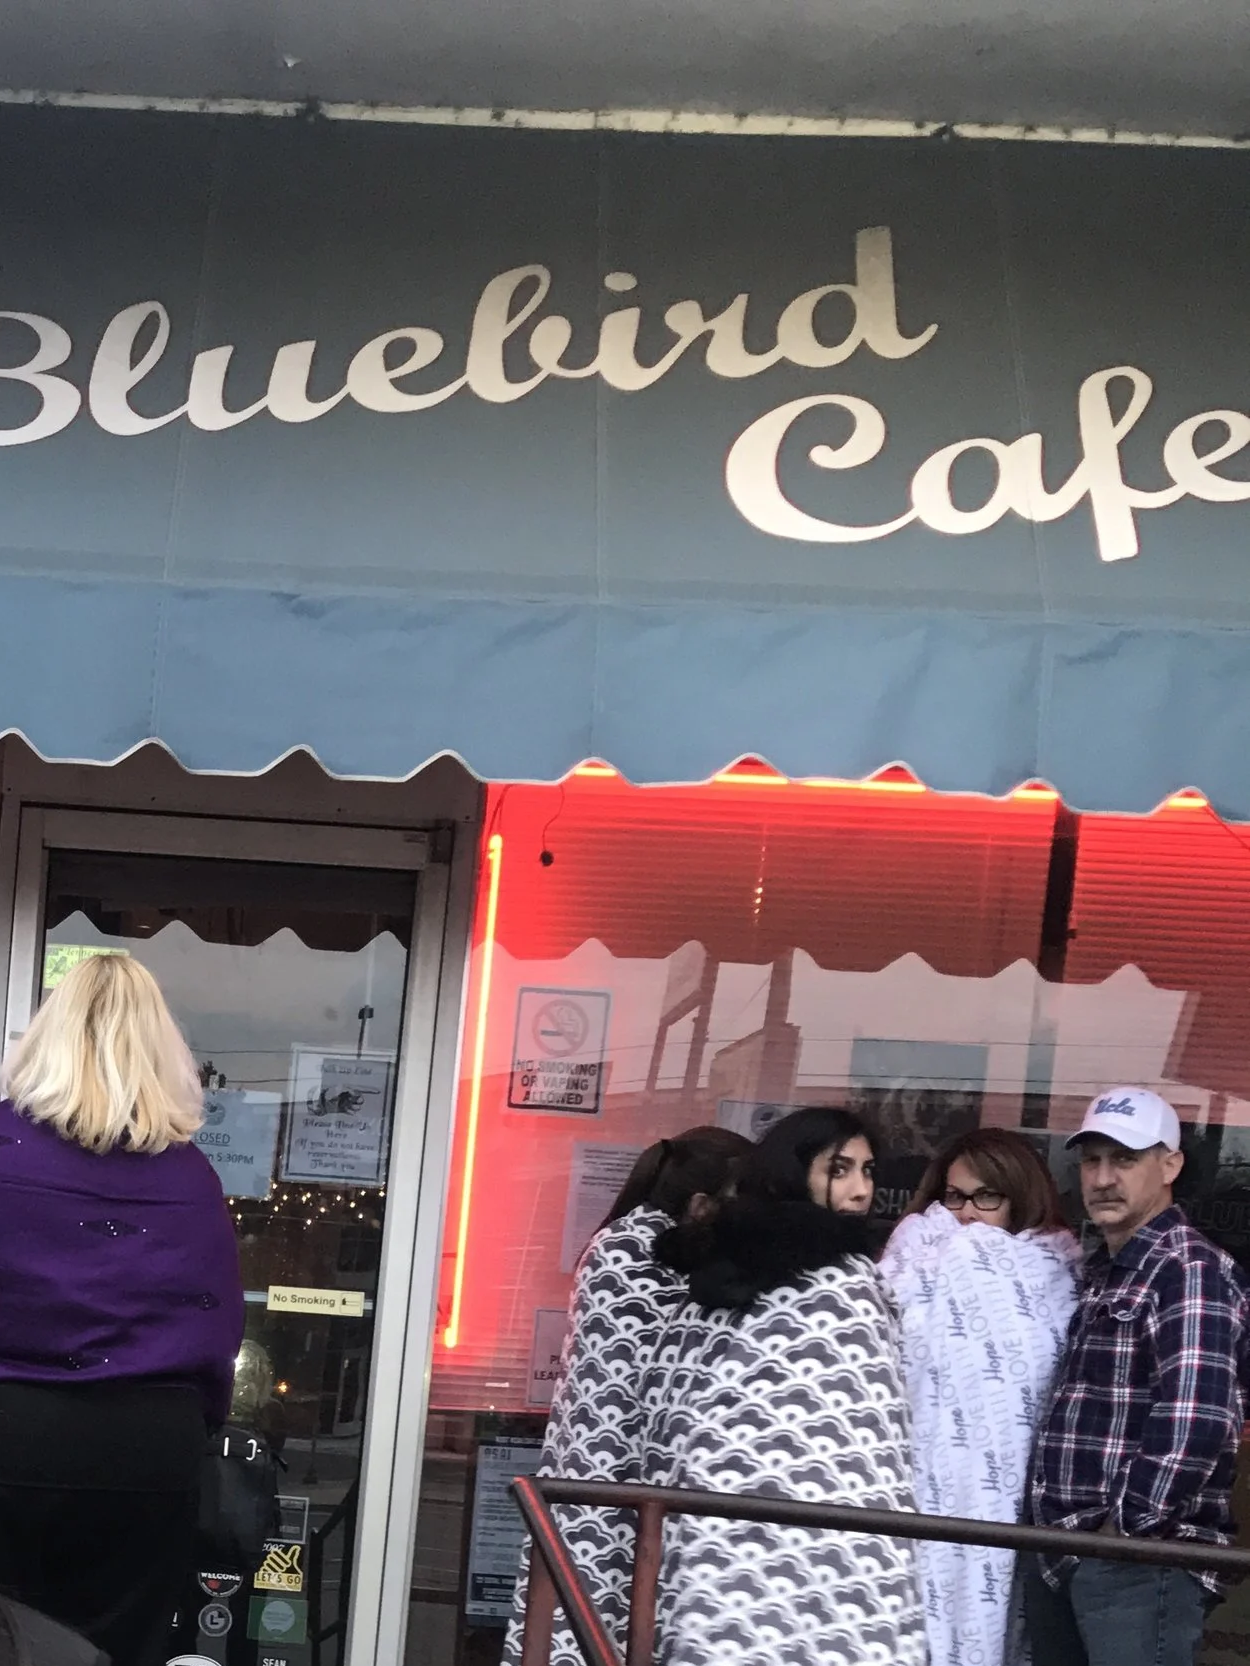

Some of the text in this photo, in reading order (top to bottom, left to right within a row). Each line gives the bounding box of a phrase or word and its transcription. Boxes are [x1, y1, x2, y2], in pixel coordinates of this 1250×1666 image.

[725, 364, 1250, 563] Cafe
[515, 1059, 597, 1076] NO SMOKING
[521, 1075, 589, 1091] OR VAPING
[522, 1090, 584, 1105] ALLOWED
[273, 1293, 336, 1307] No Smoking
[981, 1339, 1005, 1384] Hope
[950, 1407, 971, 1449] Hope
[979, 1450, 1002, 1494] Hope
[288, 1575, 301, 1585] GO
[978, 1561, 999, 1605] Hope
